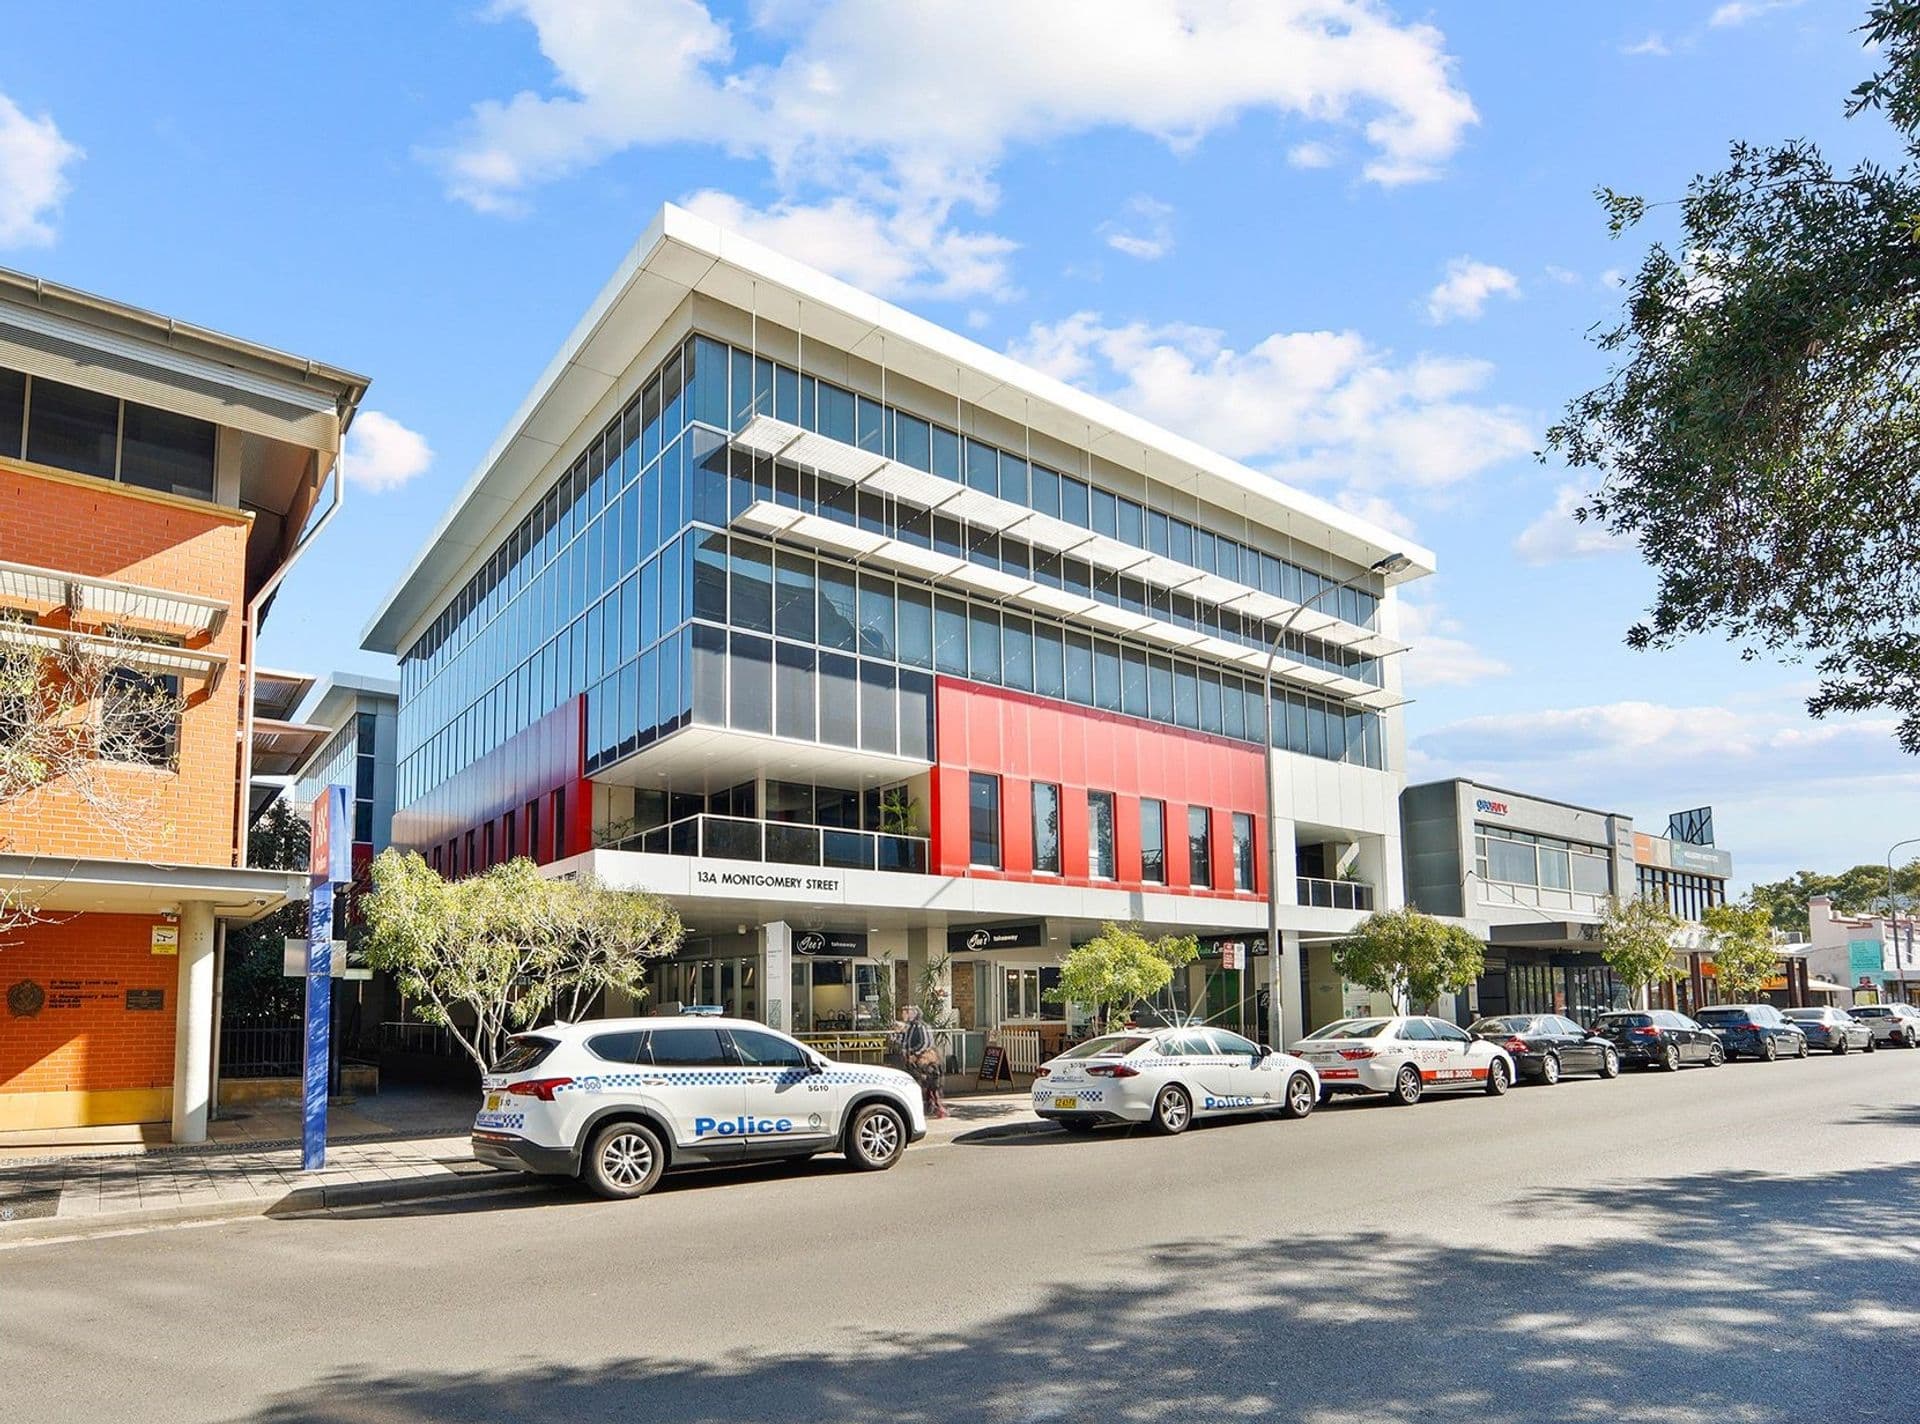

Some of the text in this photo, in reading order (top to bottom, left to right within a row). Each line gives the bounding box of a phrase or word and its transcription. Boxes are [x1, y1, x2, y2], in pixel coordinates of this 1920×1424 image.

[697, 871, 839, 891] 13A MONTGOMERY STREET
[831, 941, 857, 949] takeaway
[1204, 1095, 1254, 1110] Police
[695, 1116, 793, 1136] Police
